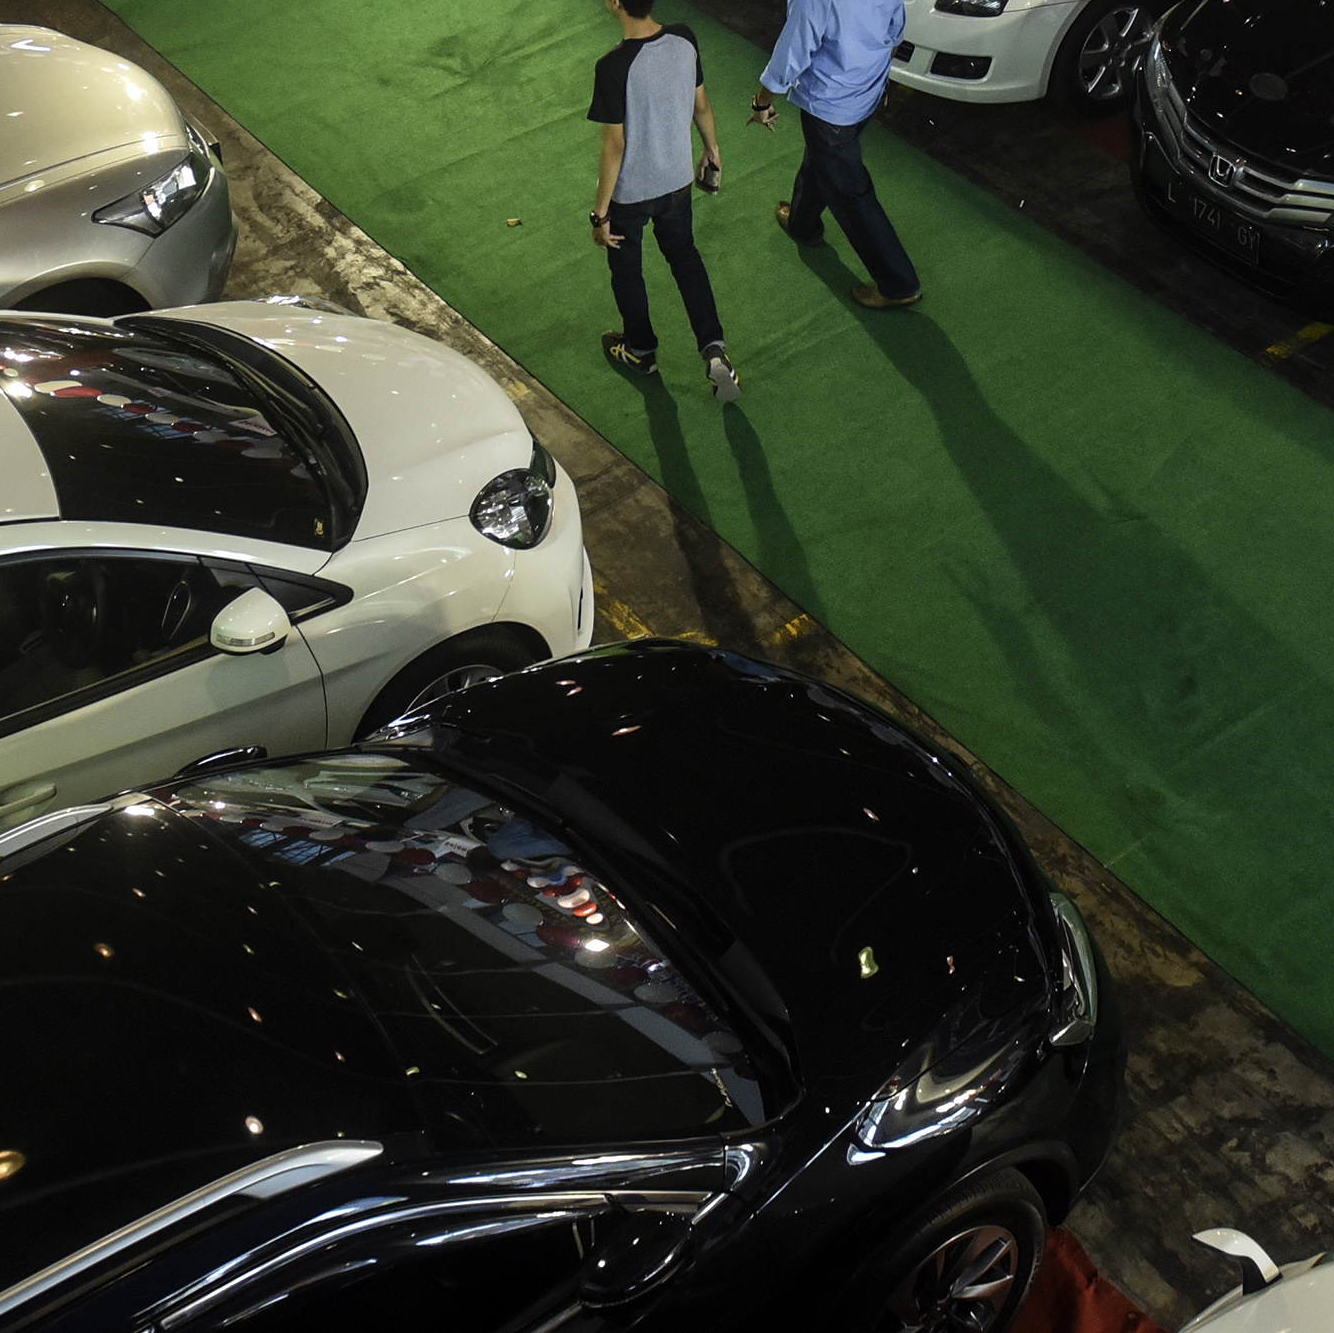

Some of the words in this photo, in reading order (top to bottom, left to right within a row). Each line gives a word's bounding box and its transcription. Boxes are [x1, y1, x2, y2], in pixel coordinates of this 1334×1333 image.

[1168, 181, 1176, 203] L
[1193, 198, 1221, 229] 1741
[1238, 226, 1256, 250] GY
